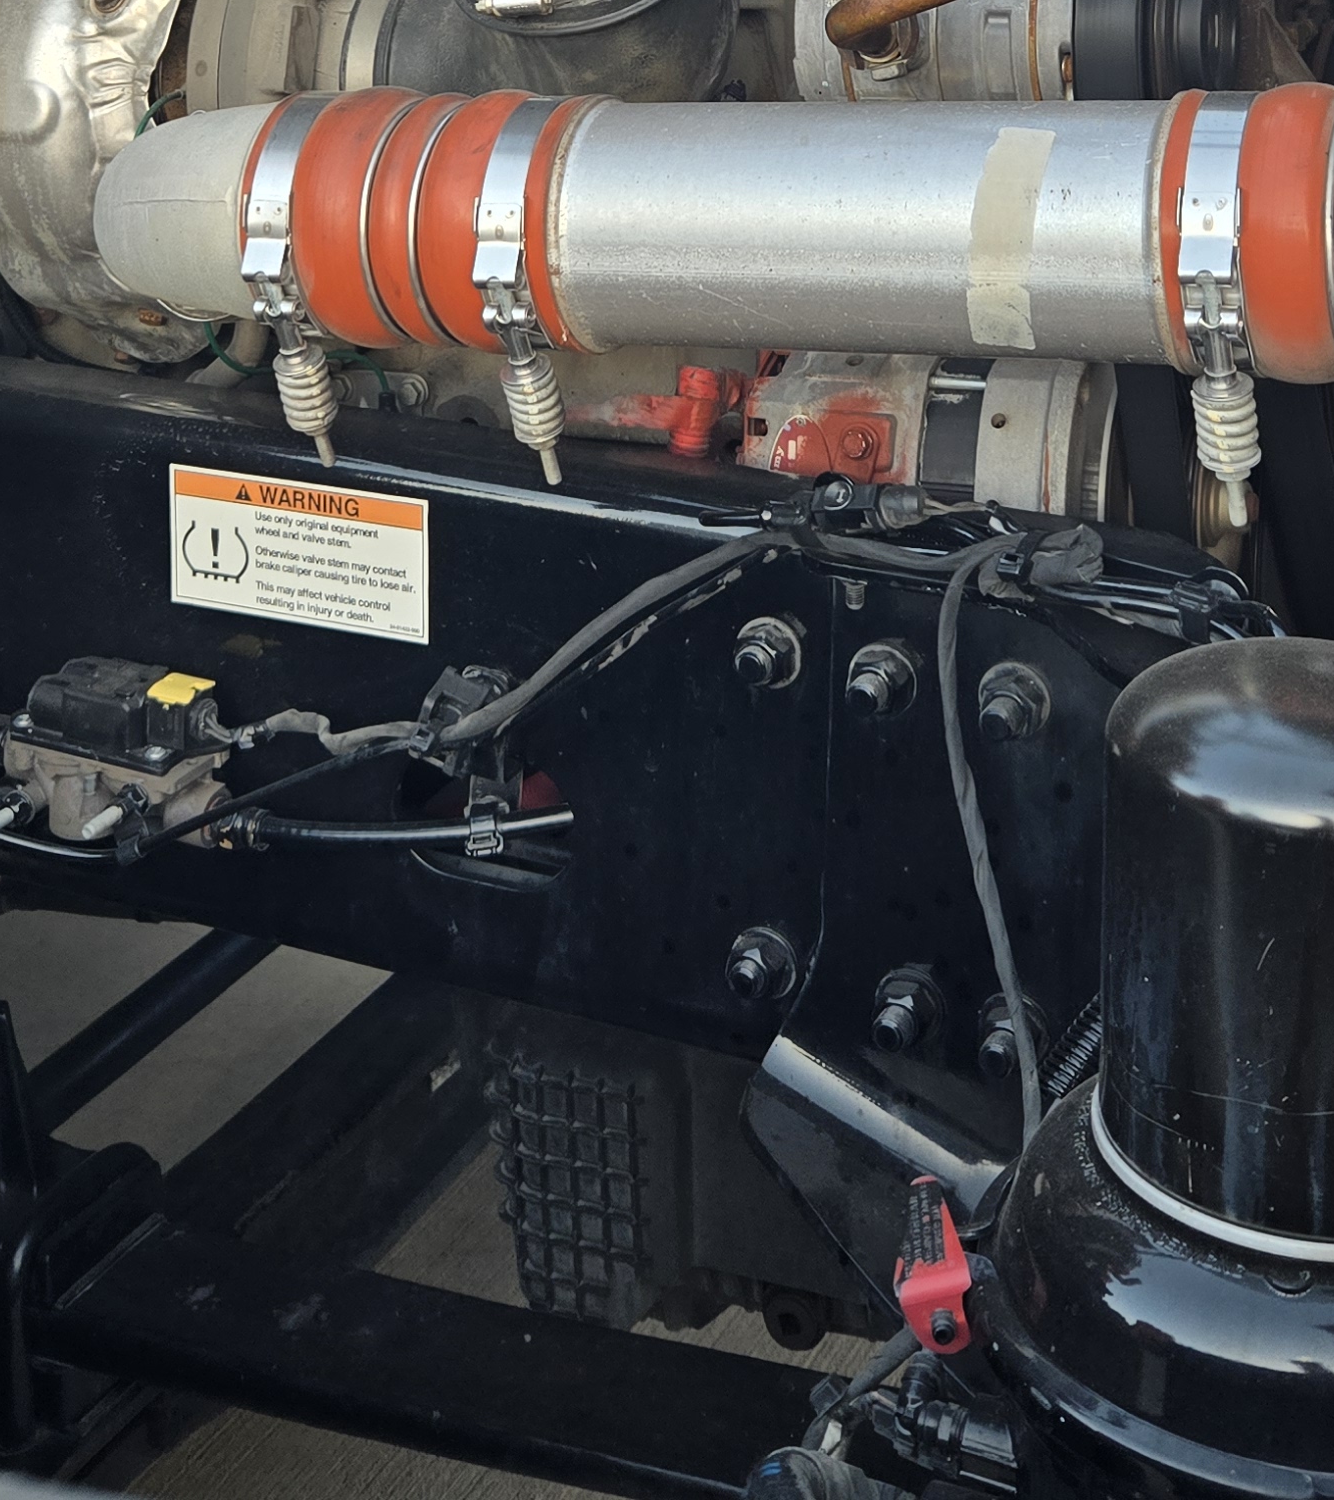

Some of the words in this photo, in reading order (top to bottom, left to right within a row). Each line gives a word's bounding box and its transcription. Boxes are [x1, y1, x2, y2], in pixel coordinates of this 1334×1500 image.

[259, 484, 360, 518] WARNING
[255, 511, 272, 523] Use
[274, 513, 293, 528] only
[295, 516, 329, 532] original
[331, 524, 379, 539] equipment
[255, 525, 280, 539] wheel
[282, 528, 299, 541] and
[301, 532, 325, 545] valve
[327, 536, 352, 549] stem.
[255, 545, 300, 561] Otherwise
[301, 553, 326, 566] valve
[327, 557, 349, 570] stem
[351, 562, 371, 575] may
[372, 564, 407, 579] contact
[255, 559, 281, 572] brake
[282, 562, 312, 579] caliper
[314, 568, 349, 585] causing
[351, 574, 367, 586] tire
[369, 577, 378, 588] to
[380, 578, 400, 592] lose
[401, 582, 417, 594] air.
[255, 580, 275, 592] This
[276, 586, 296, 599] may
[296, 587, 323, 601] affect
[324, 591, 357, 606] vehicle
[358, 597, 391, 612] control
[255, 594, 295, 610] resulting
[296, 601, 305, 612] in
[307, 603, 332, 618] injury
[333, 608, 345, 618] or
[346, 609, 374, 623] death.
